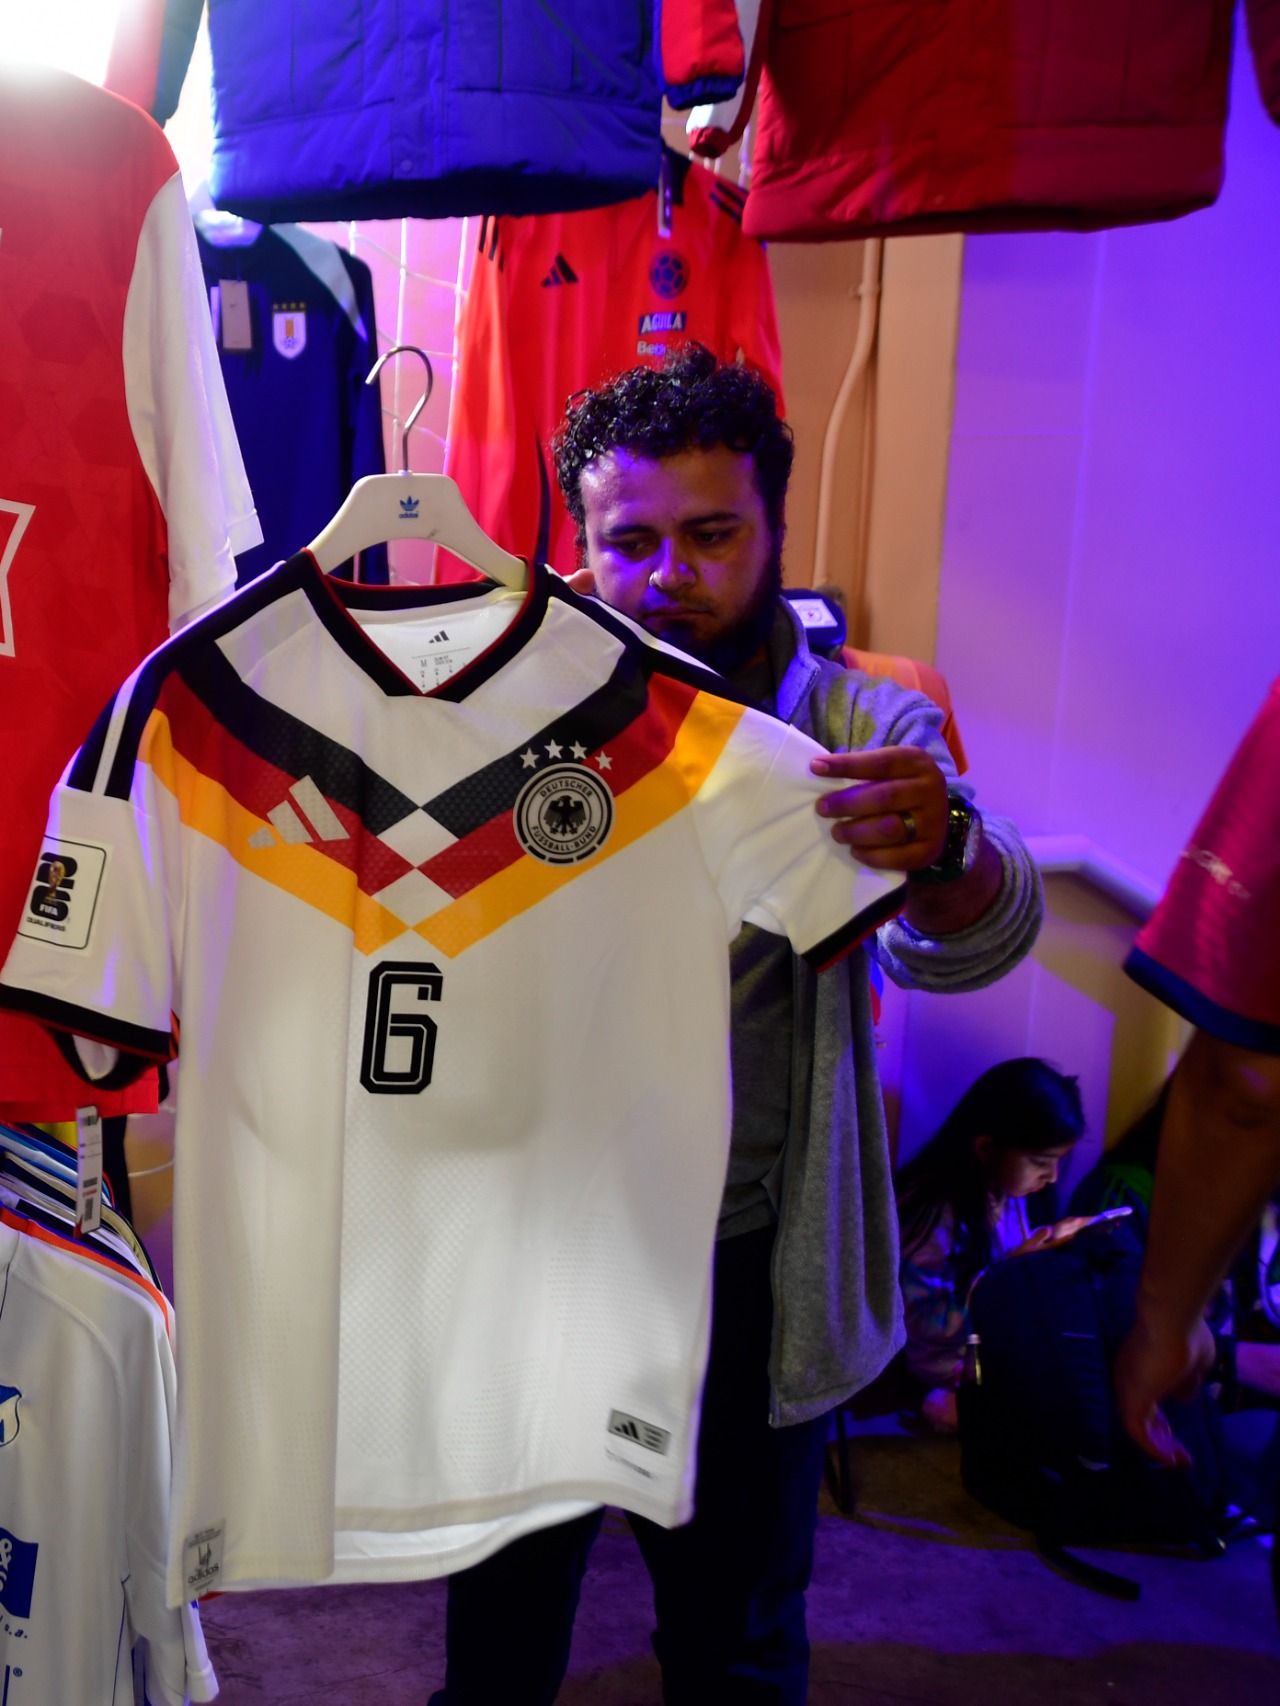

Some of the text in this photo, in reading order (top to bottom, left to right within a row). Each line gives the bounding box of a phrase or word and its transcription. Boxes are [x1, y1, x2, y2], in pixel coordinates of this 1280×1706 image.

[540, 779, 594, 798] DEUTSCHER
[531, 824, 597, 851] FUSSBALL-BUND
[39, 903, 59, 916] FIFA
[26, 916, 66, 932] QUALIFIERS
[360, 960, 444, 1095] 6
[188, 1562, 219, 1584] adidas
[4, 1623, 28, 1639] s.a.
